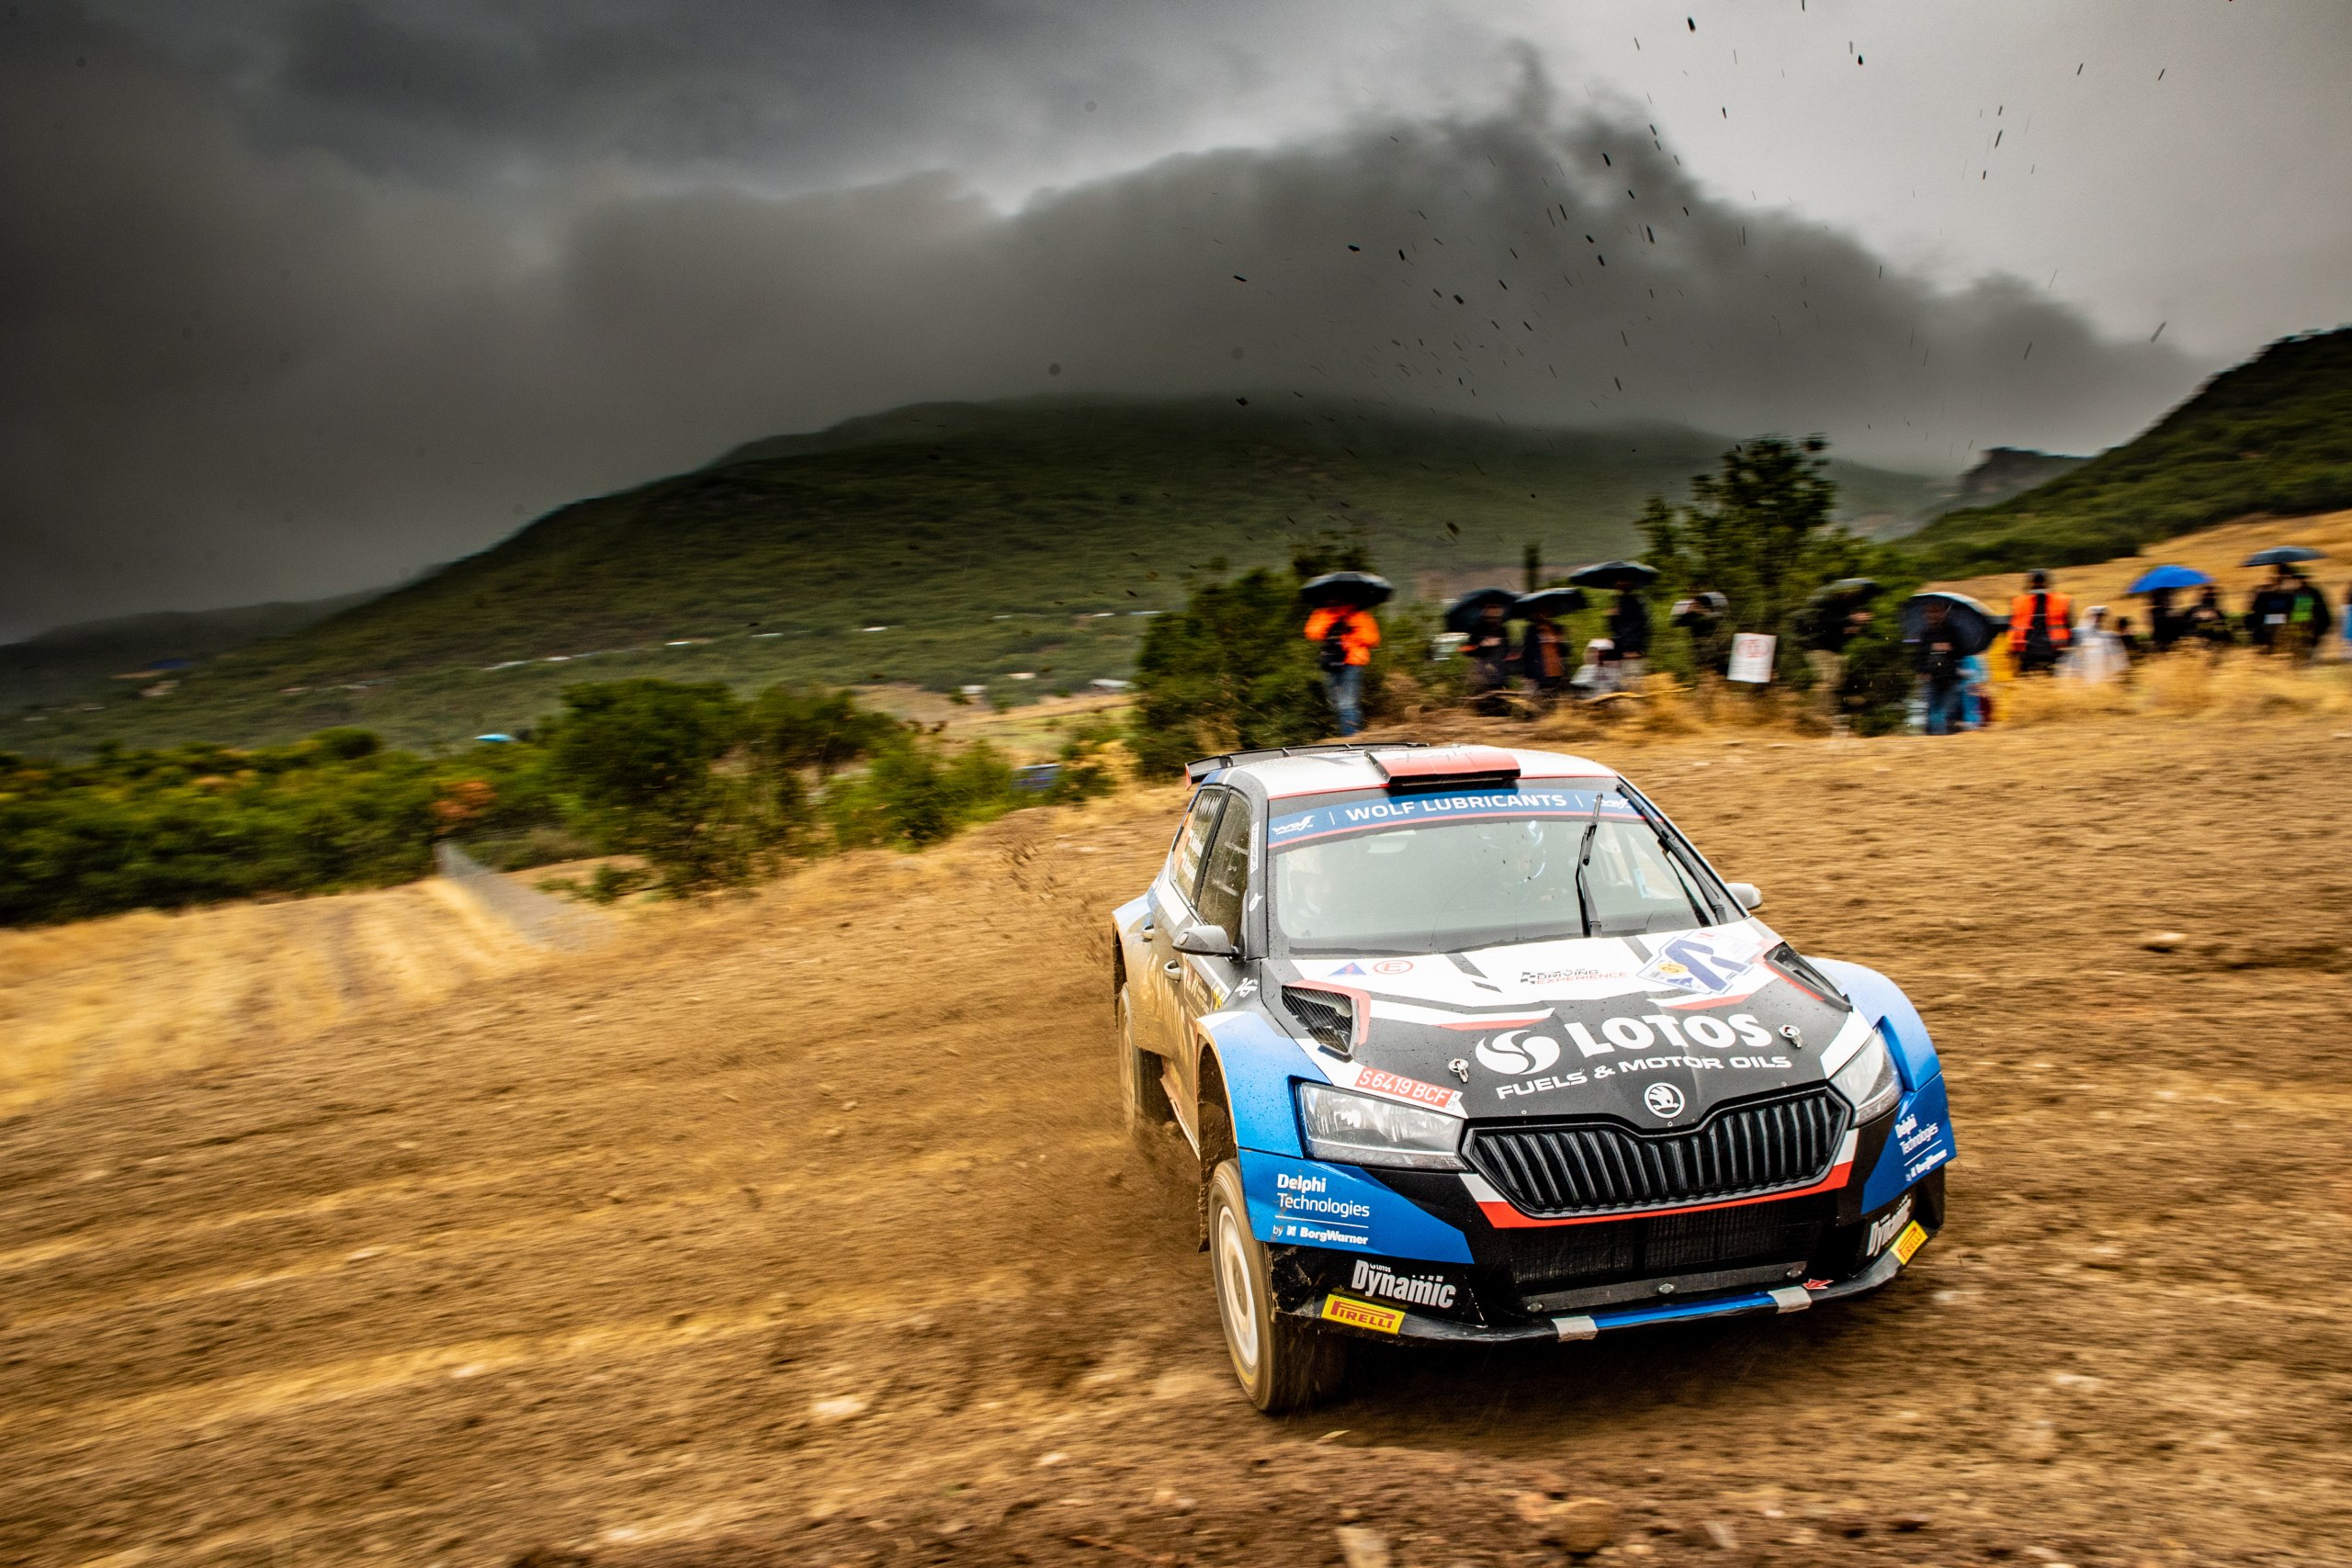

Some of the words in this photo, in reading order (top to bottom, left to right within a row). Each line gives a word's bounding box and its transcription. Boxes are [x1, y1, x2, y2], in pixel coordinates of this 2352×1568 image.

[1346, 802, 1415, 821] WOLF
[1421, 794, 1567, 812] LUBRICANTS
[1536, 972, 1627, 985] EXPERIENCE
[1537, 969, 1599, 980] DRIVING
[1564, 1013, 1773, 1057] LOTOS
[1496, 1069, 1589, 1100] FUELS
[1593, 1065, 1616, 1079] &
[1617, 1055, 1725, 1074] MOTOR
[1731, 1055, 1792, 1069] OILS
[1412, 1084, 1451, 1103] BCF
[1894, 1113, 1917, 1138] Delphi
[1277, 1173, 1327, 1193] Delphi
[1277, 1192, 1370, 1218] Technologies
[1272, 1224, 1283, 1236] by
[1300, 1226, 1369, 1245] BorgWarner
[1375, 1264, 1392, 1273] LOTOS
[1351, 1259, 1457, 1309] Dynamic
[1330, 1300, 1396, 1329] PIRELLI
